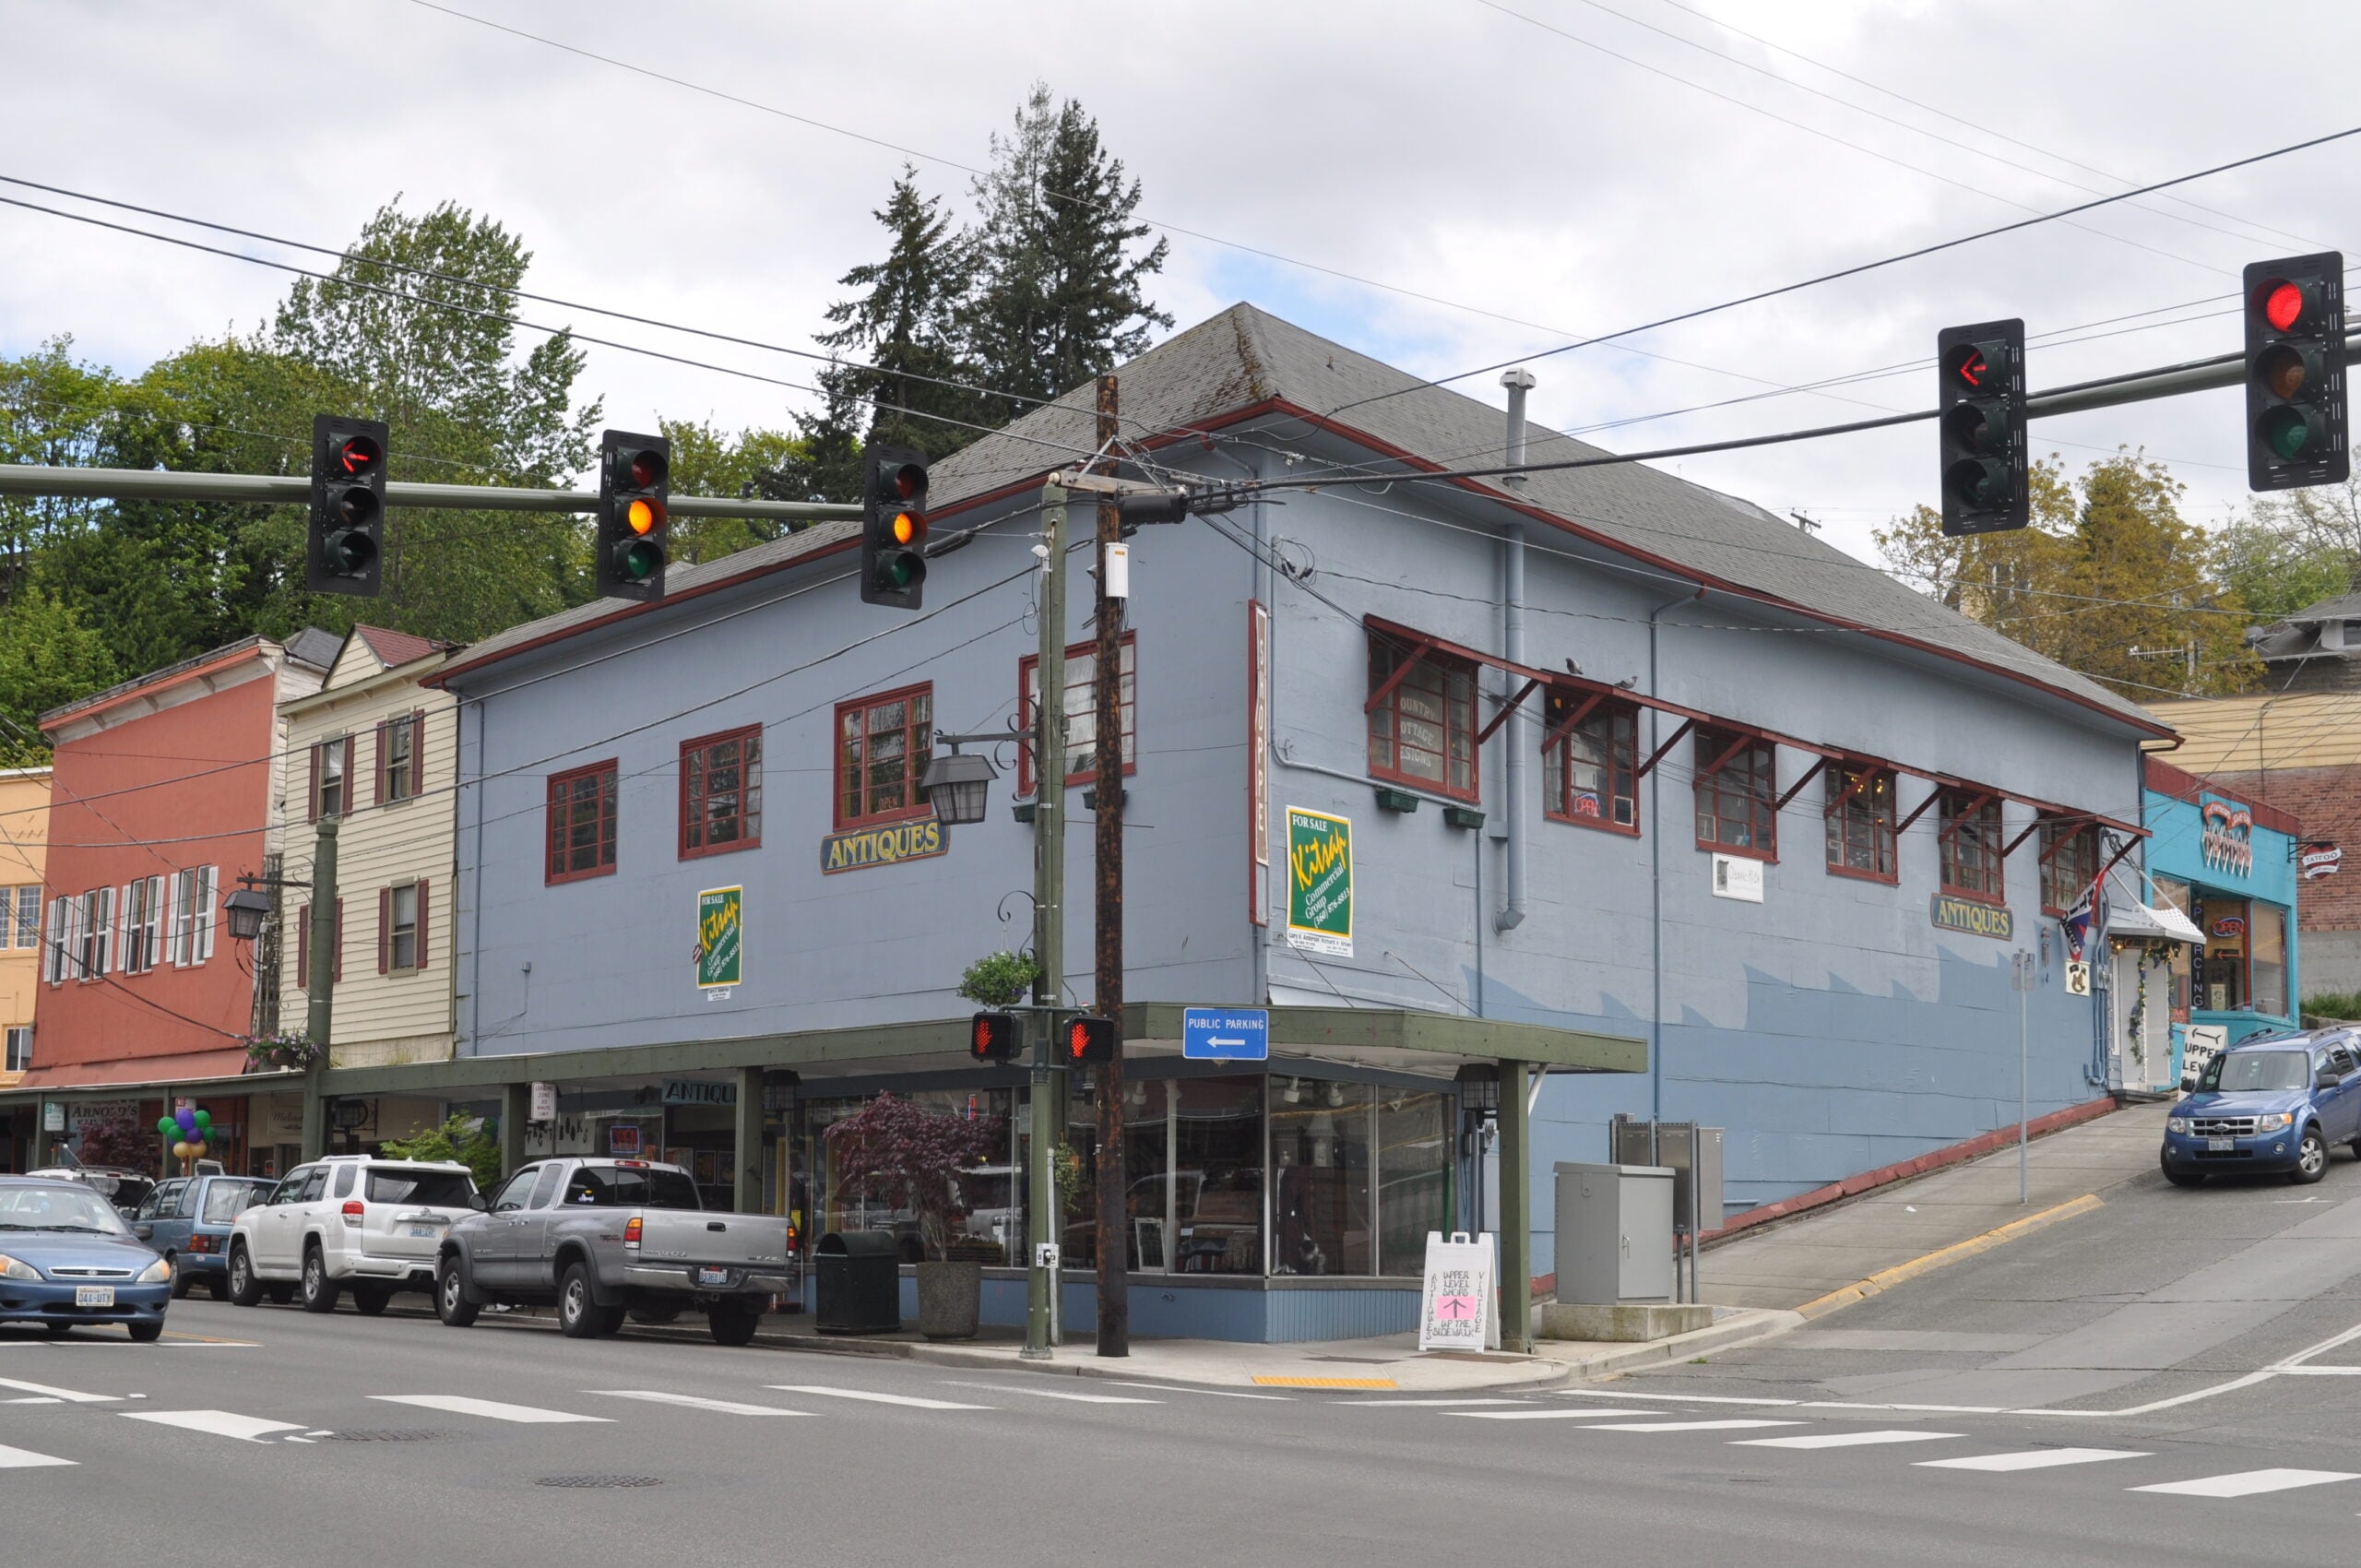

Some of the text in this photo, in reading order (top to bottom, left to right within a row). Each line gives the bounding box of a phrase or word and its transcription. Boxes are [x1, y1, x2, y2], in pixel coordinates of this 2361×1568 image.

[1400, 696, 1435, 720] OUNTRY
[1400, 721, 1434, 746] OTTAGE
[1400, 745, 1431, 767] ESIGNS
[878, 796, 897, 810] OPEN
[1292, 814, 1328, 832] FOR SALE
[827, 822, 940, 868] ANTIQUES
[2205, 831, 2252, 867] TATTOO
[1292, 826, 1347, 891] Kitsap
[2306, 852, 2337, 863] TATTOO
[1305, 861, 1345, 906] Commercial
[701, 894, 725, 906] FOR SALE
[1305, 895, 1327, 920] Group
[1313, 886, 1350, 929] (360) 876-8813
[701, 895, 738, 956] Kitsap
[1938, 900, 2010, 936] ANTIQUES
[2213, 921, 2244, 933] OPEN
[707, 923, 735, 967] Commercial
[2193, 907, 2203, 1006] PIRCING
[707, 954, 721, 977] Group
[1188, 1018, 1264, 1030] PUBLIC PARKING
[2182, 1059, 2205, 1073] LEV
[559, 1117, 588, 1144] BOOKS
[1442, 1270, 1470, 1279] UPPER
[1443, 1279, 1470, 1288] LEVEL
[1442, 1288, 1469, 1297] SHOPS
[1475, 1272, 1485, 1333] VINTAGE
[1426, 1273, 1437, 1340] ANTIQUES
[1441, 1320, 1471, 1328] UP THE
